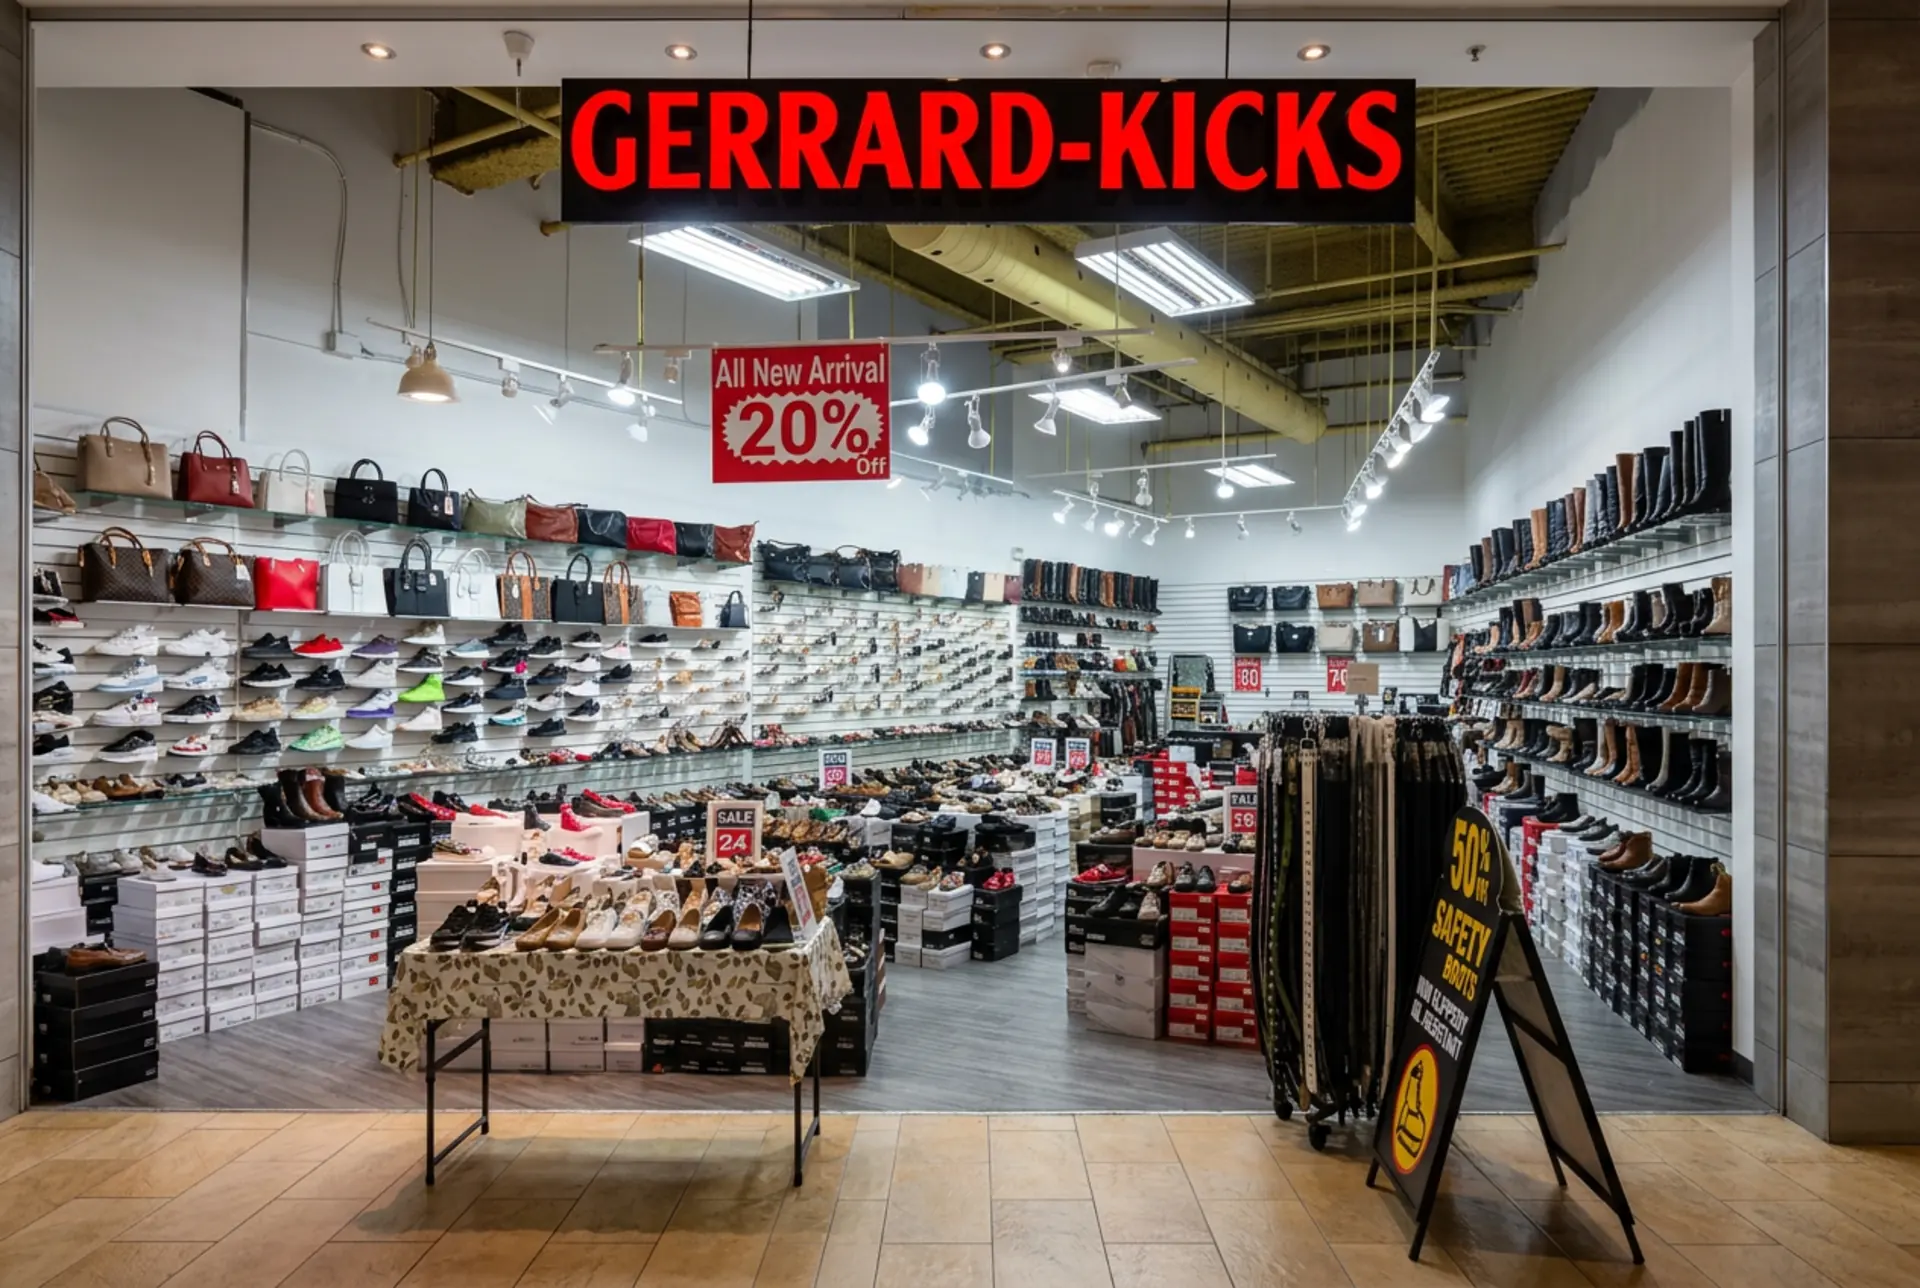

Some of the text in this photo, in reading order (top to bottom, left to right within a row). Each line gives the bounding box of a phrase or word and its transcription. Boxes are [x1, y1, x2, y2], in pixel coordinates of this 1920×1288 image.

[570, 90, 1402, 192] GERRARD-KICKS
[715, 353, 885, 388] All New Arrival
[739, 399, 869, 456] 20%
[856, 457, 887, 475] Off
[718, 811, 753, 824] SALE
[1451, 818, 1490, 898] 50%
[1432, 898, 1492, 968] SAFETY
